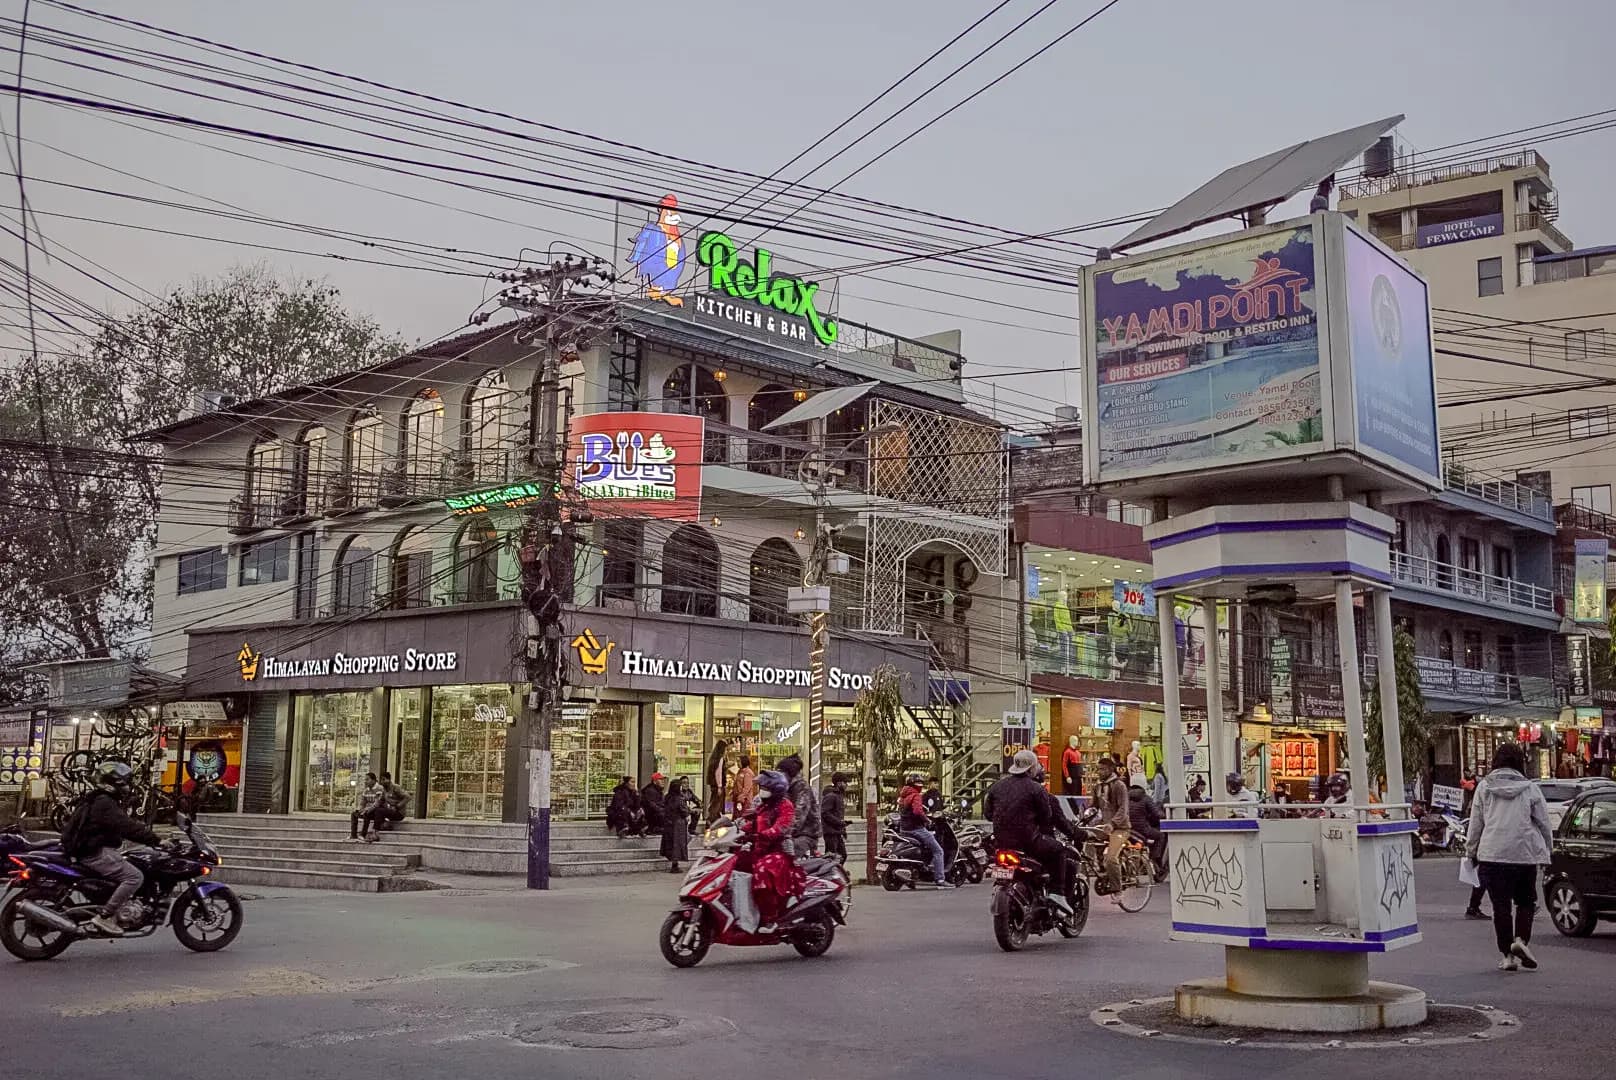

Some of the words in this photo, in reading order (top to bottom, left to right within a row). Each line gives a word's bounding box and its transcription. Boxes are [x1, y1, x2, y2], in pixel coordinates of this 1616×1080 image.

[1426, 233, 1458, 244] FEWA
[1460, 226, 1495, 239] CAMP
[1444, 220, 1476, 232] HOTEL
[696, 230, 838, 346] Relax
[697, 296, 761, 329] KITCHEN
[767, 317, 776, 332] &
[781, 321, 806, 341] BAR
[1103, 299, 1202, 346] YAMDI
[1149, 337, 1204, 354] SWIMMING
[1205, 329, 1232, 343] POOL
[1234, 326, 1243, 337] &
[1244, 318, 1287, 336] RESTRO
[1289, 314, 1310, 327] INN
[1109, 367, 1130, 381] OUR
[1133, 358, 1181, 377] SERVICES
[1259, 383, 1290, 395] Yamdi
[1123, 591, 1146, 606] 70%
[262, 656, 330, 678] HIMALAYAN
[333, 652, 400, 675] SHOPPING
[404, 648, 457, 671] STORE
[621, 650, 733, 681] HIMALAYAN
[828, 666, 873, 691] STOR
